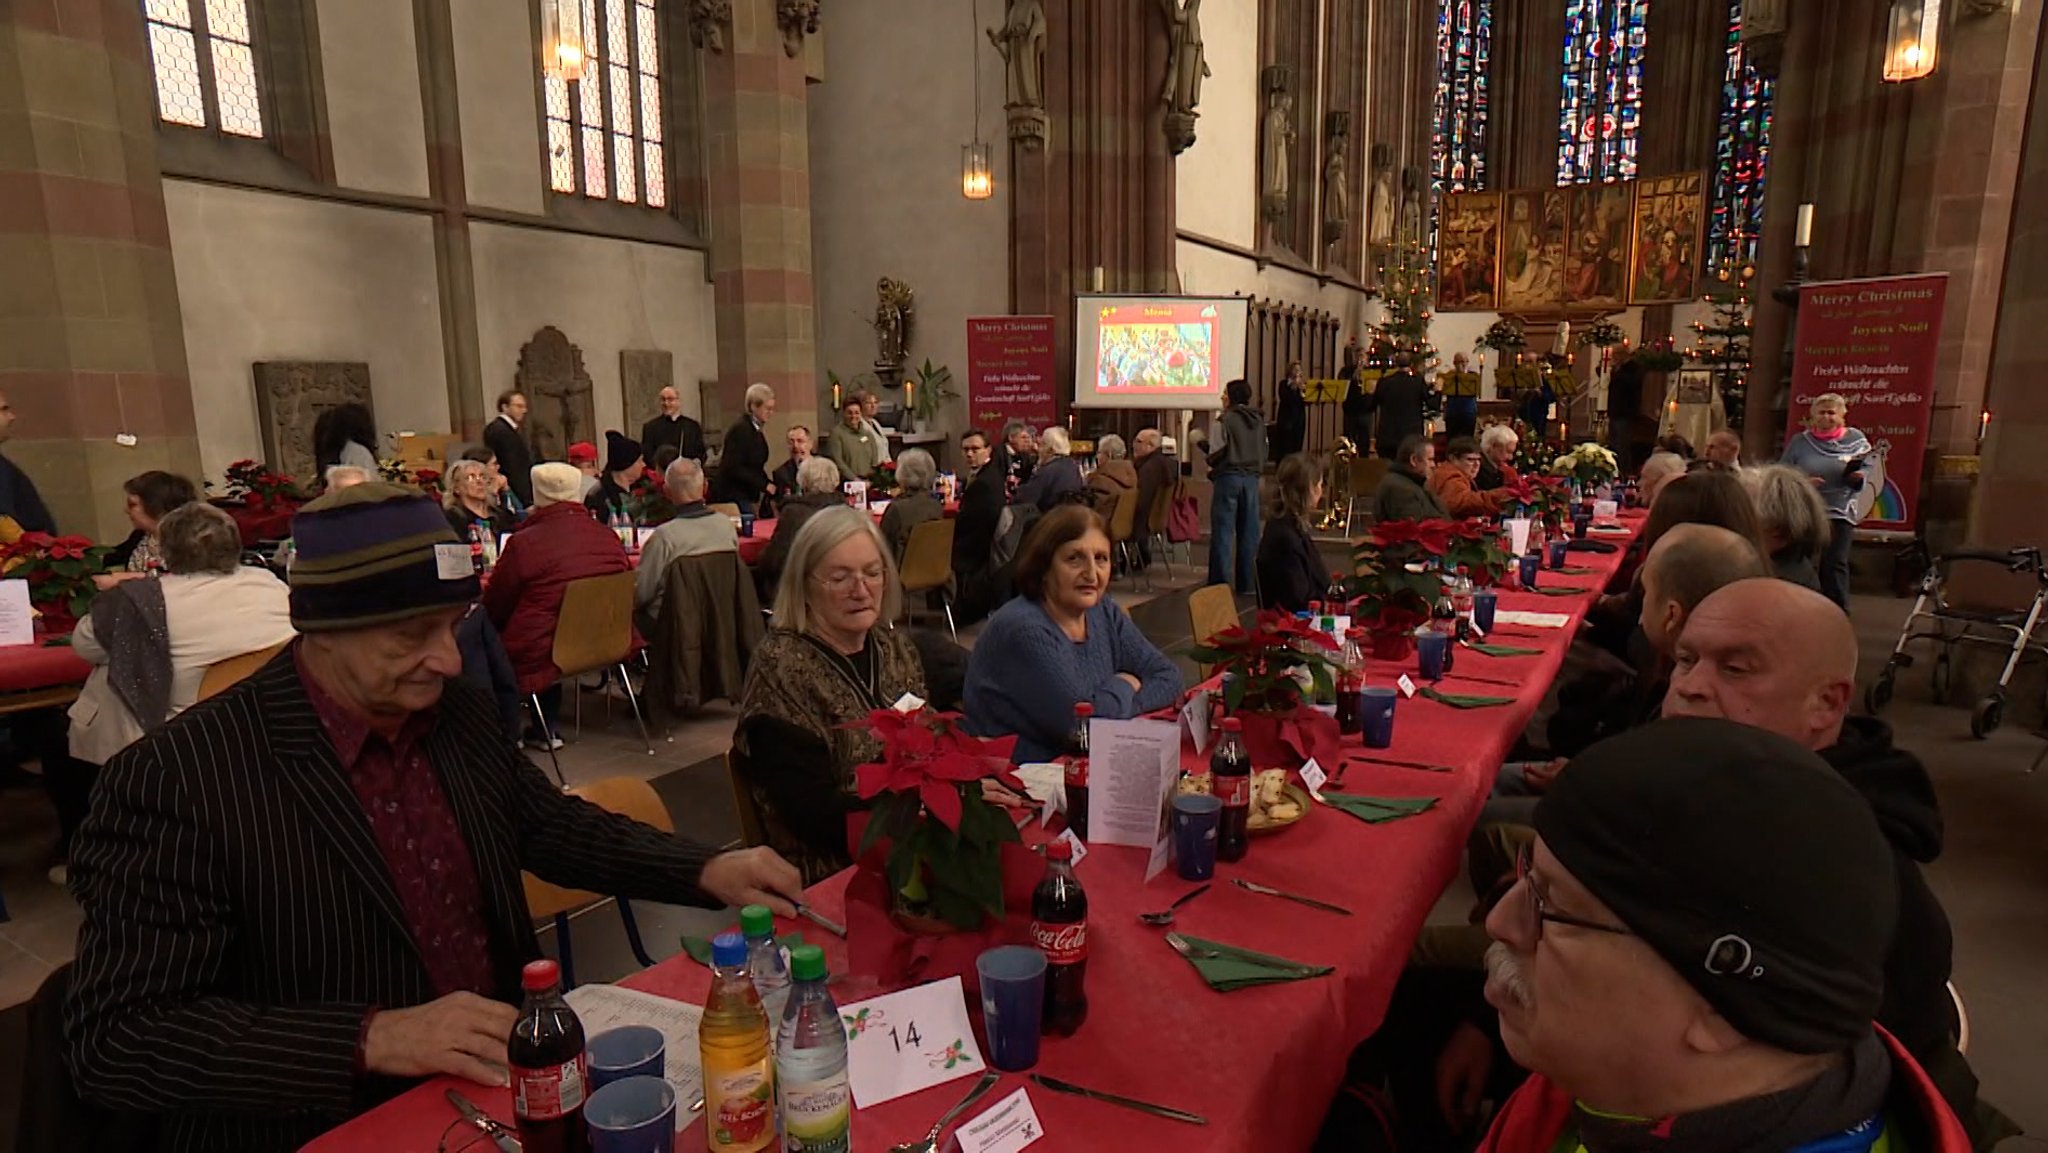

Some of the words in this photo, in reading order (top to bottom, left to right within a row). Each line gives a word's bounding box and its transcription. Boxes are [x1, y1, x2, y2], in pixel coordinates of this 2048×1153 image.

[1810, 294, 1854, 306] Merry
[1858, 288, 1933, 303] Christmas
[1851, 324, 1894, 336] Joyeux
[1899, 321, 1929, 333] Noël
[1878, 424, 1916, 435] Natale
[888, 1020, 922, 1053] 14
